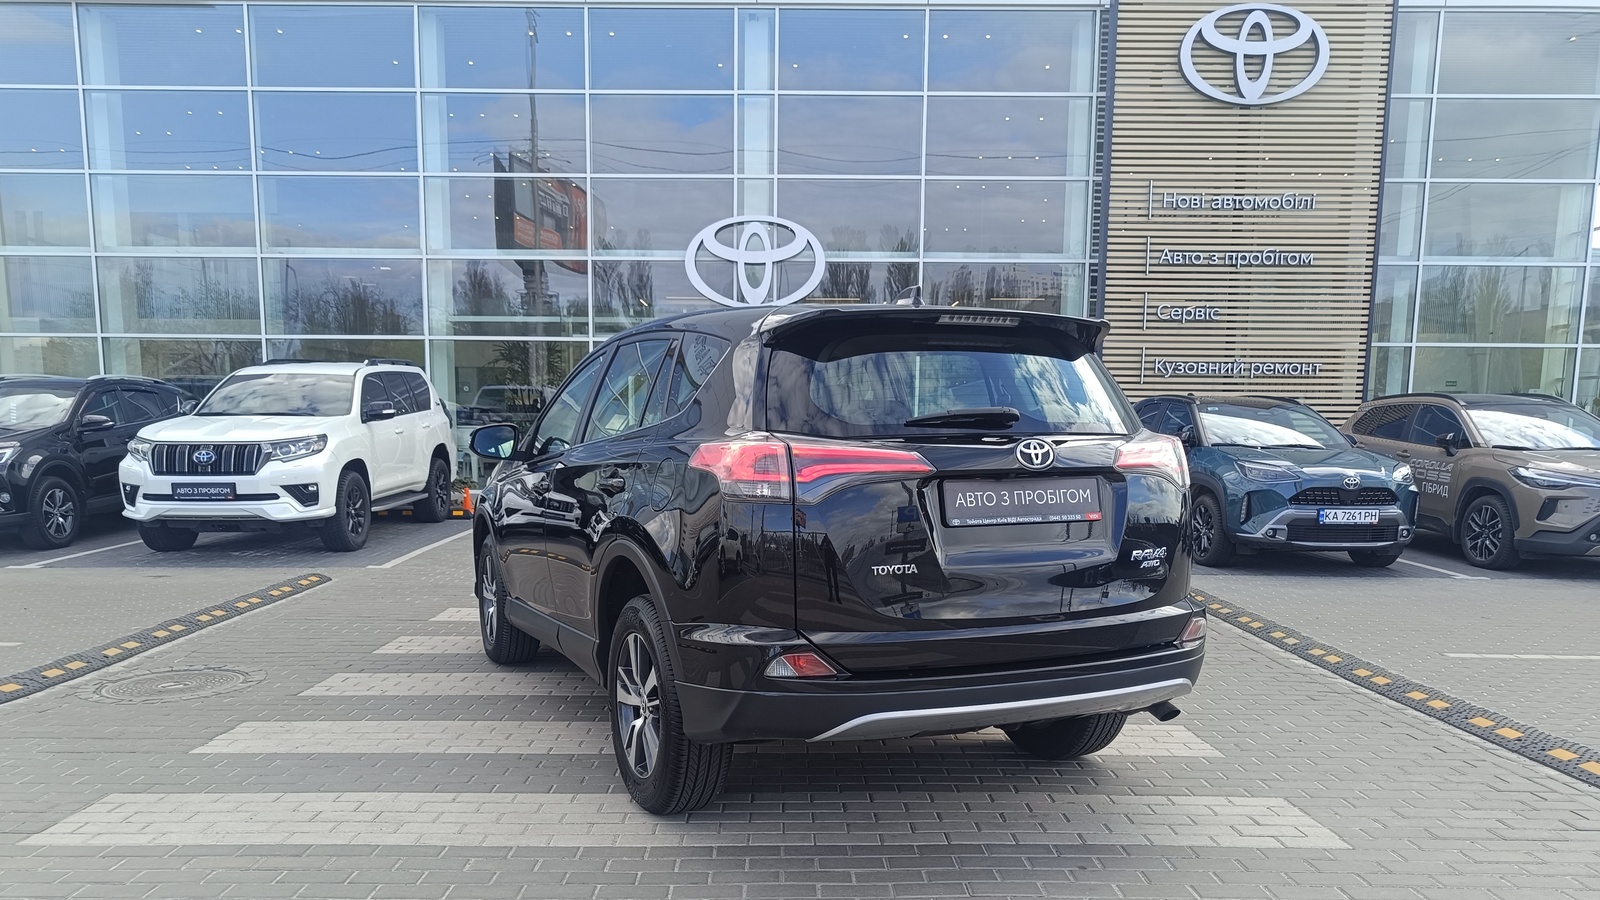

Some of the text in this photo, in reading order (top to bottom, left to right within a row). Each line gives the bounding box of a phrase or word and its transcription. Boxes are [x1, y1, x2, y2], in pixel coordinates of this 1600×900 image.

[1163, 192, 1317, 210] Нові автомобілі
[1159, 248, 1314, 269] Авто з пробігом
[1157, 303, 1221, 324] Сервіс
[1154, 358, 1322, 378] Кузовний ремонт
[1410, 458, 1454, 471] COROLLA
[955, 491, 997, 508] АВТО
[1014, 488, 1091, 505] ПРОБІГОМ
[1421, 481, 1449, 498] ГІБРИД
[1325, 511, 1377, 521] KA 7261 PH
[1130, 546, 1167, 561] RAV4
[871, 564, 918, 576] TOYOTA
